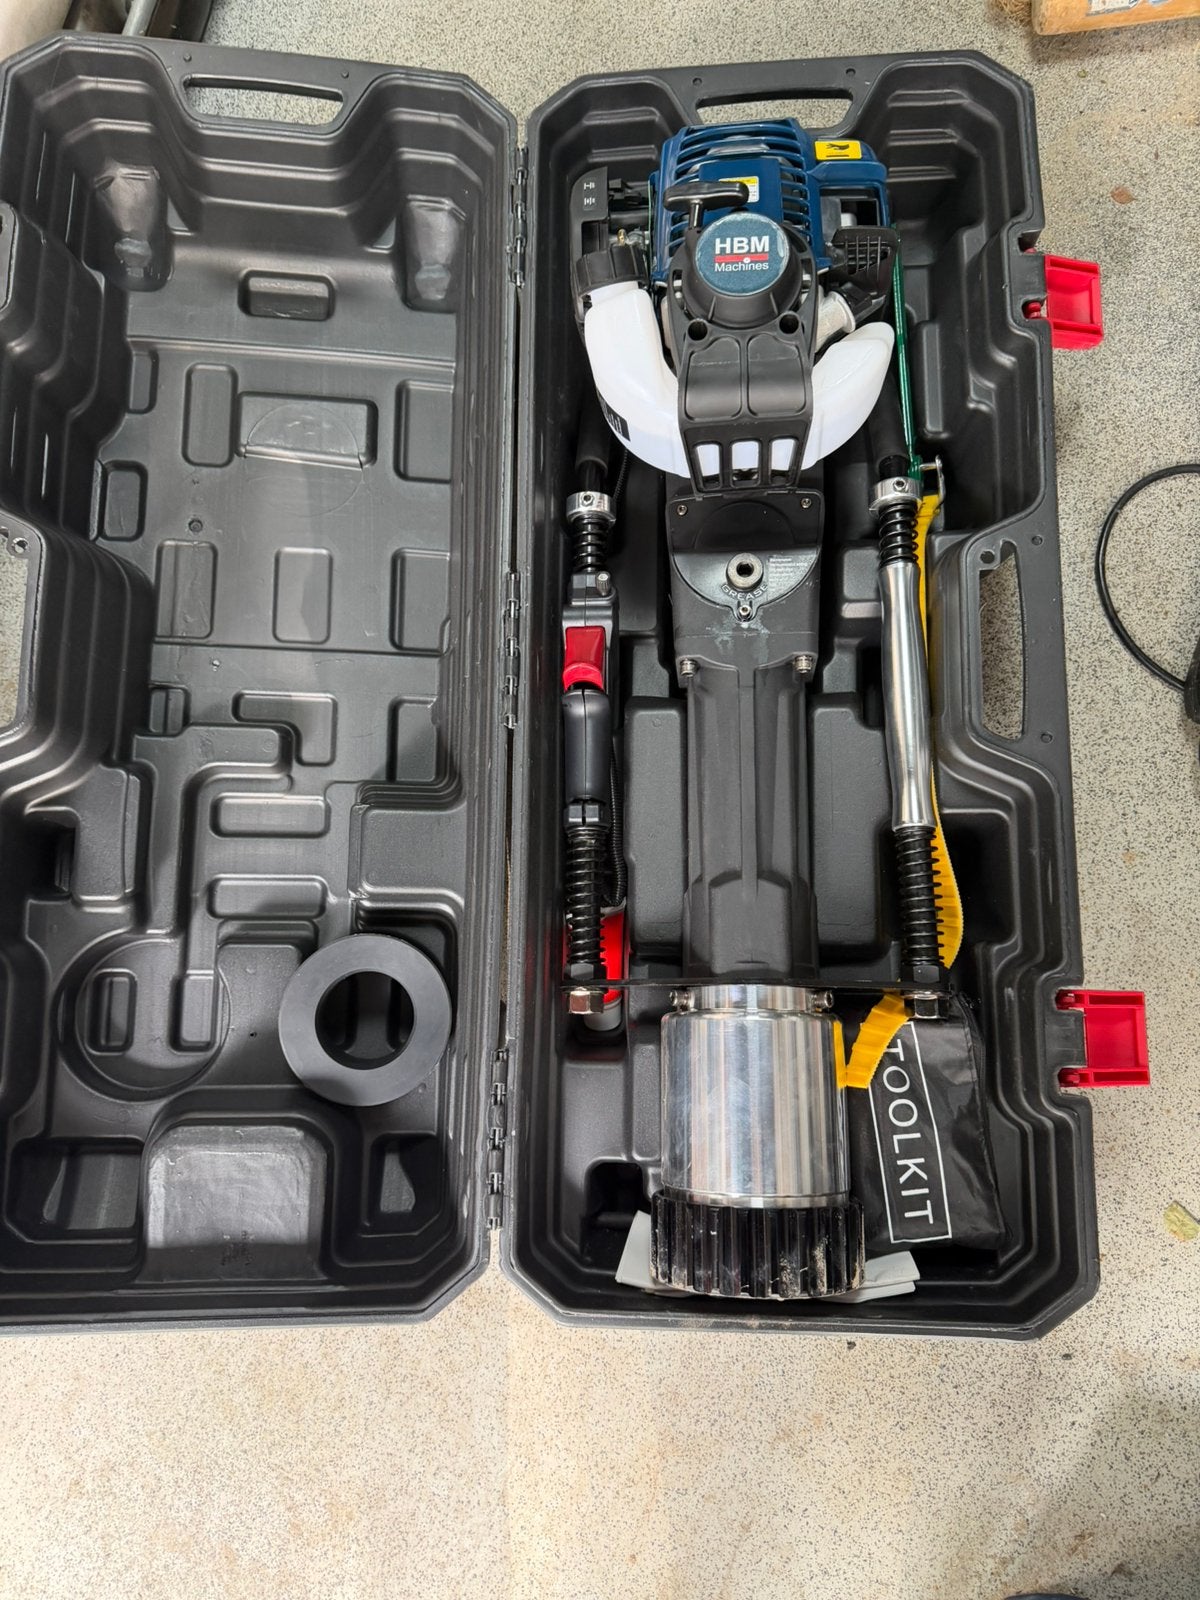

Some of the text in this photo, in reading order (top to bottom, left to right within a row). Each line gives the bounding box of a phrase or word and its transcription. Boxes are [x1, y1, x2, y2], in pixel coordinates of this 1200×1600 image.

[715, 236, 769, 254] HBM
[714, 262, 769, 272] Machines
[721, 583, 768, 600] GREASE
[882, 1038, 934, 1225] TOOLKIT
